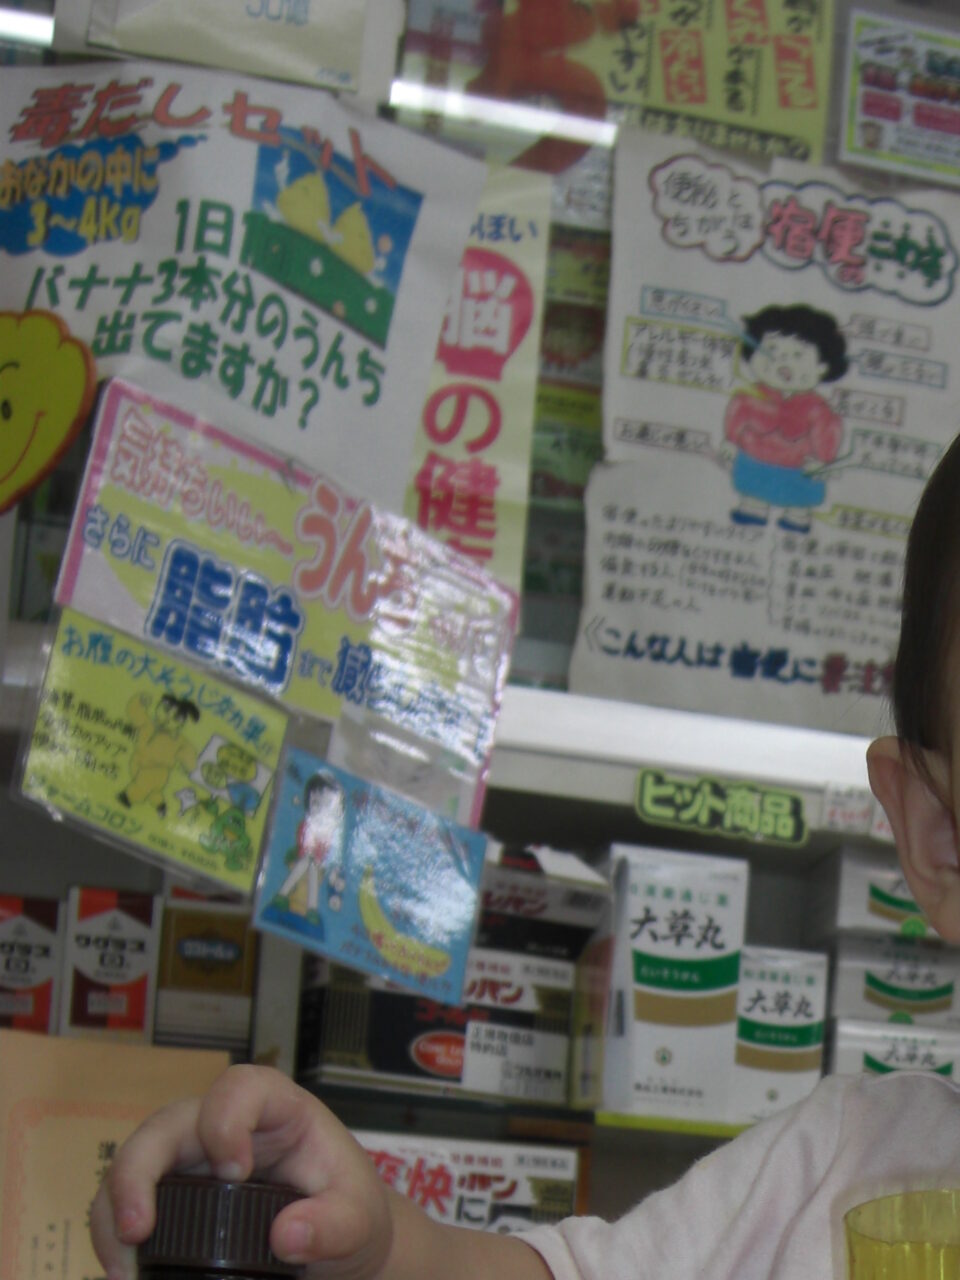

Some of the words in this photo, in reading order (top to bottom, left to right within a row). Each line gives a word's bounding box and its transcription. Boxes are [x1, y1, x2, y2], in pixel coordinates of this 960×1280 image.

[174, 199, 234, 258] 1日
[639, 772, 795, 838] ヒット商品
[629, 903, 726, 950] 大草丸
[744, 988, 815, 1019] 大草丸
